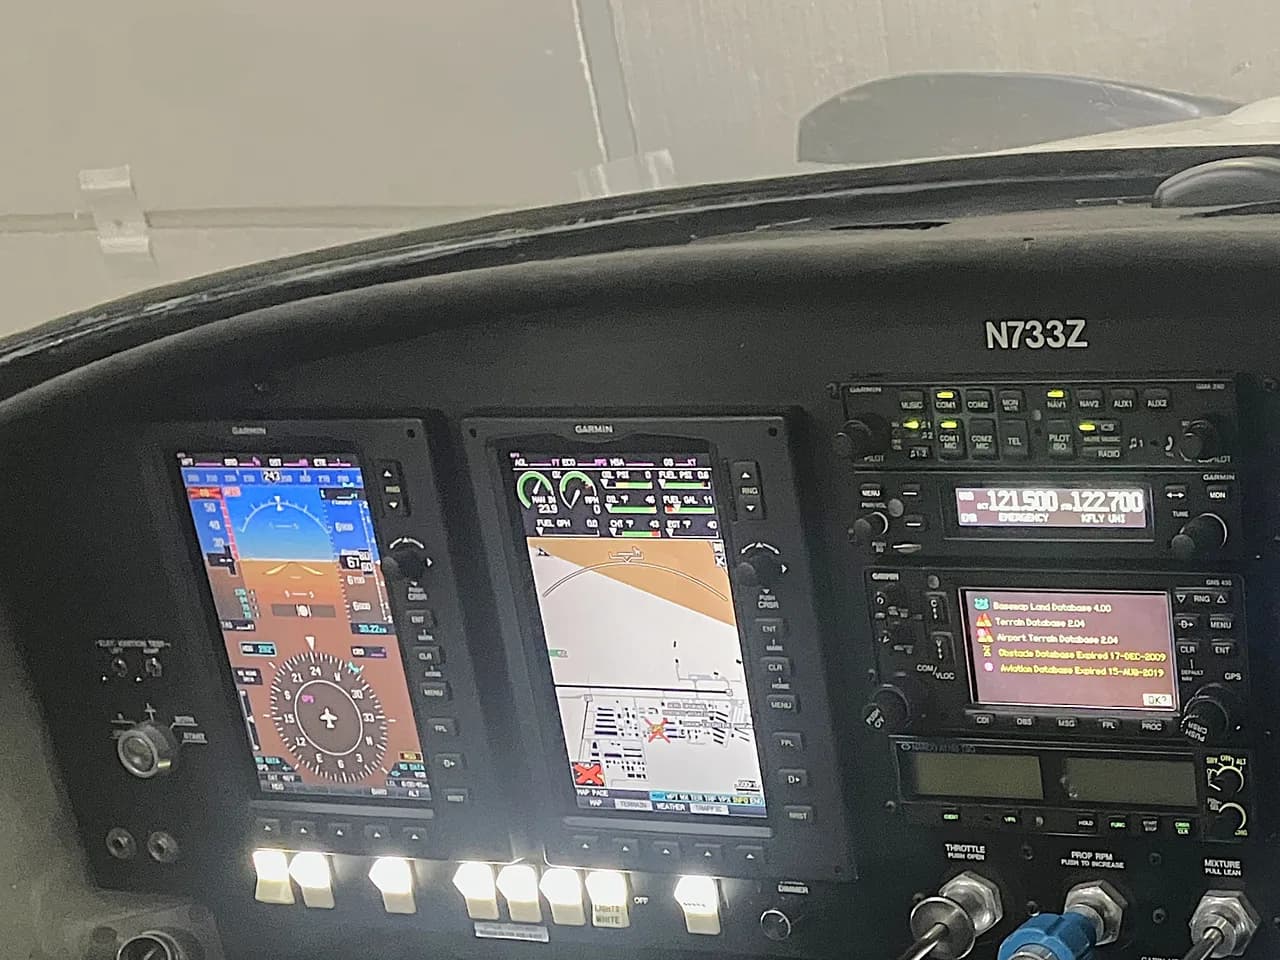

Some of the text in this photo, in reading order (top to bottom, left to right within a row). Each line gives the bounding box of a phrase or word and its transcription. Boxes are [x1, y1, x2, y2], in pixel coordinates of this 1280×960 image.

[985, 319, 1088, 349] N733Z
[1113, 400, 1132, 408] AUX1
[1008, 438, 1021, 446] TEL
[263, 471, 280, 481] 243
[1193, 595, 1211, 603] RNG
[1052, 603, 1092, 613] Database
[995, 617, 1024, 627] Terrain
[1026, 618, 1066, 628] Database
[1210, 621, 1231, 629] MENU
[1059, 635, 1099, 645] Database
[1180, 646, 1195, 654] CLR
[1215, 646, 1230, 654] ENT
[1035, 650, 1075, 660] Database
[1076, 651, 1108, 661] Expired
[1034, 665, 1073, 675] Database
[1074, 666, 1108, 676] Expired
[1225, 672, 1242, 681] GPS
[976, 716, 989, 724] CDI
[1102, 721, 1116, 729] FPL
[945, 843, 985, 854] THROTTLE
[948, 852, 985, 861] PUSH OPEN
[1071, 851, 1113, 861] PROP RPM
[1061, 859, 1125, 869] PUSH TO INCREASE
[1204, 859, 1241, 870] MIXTURE
[1205, 868, 1242, 877] PULL LEAN
[634, 896, 648, 904] OFF
